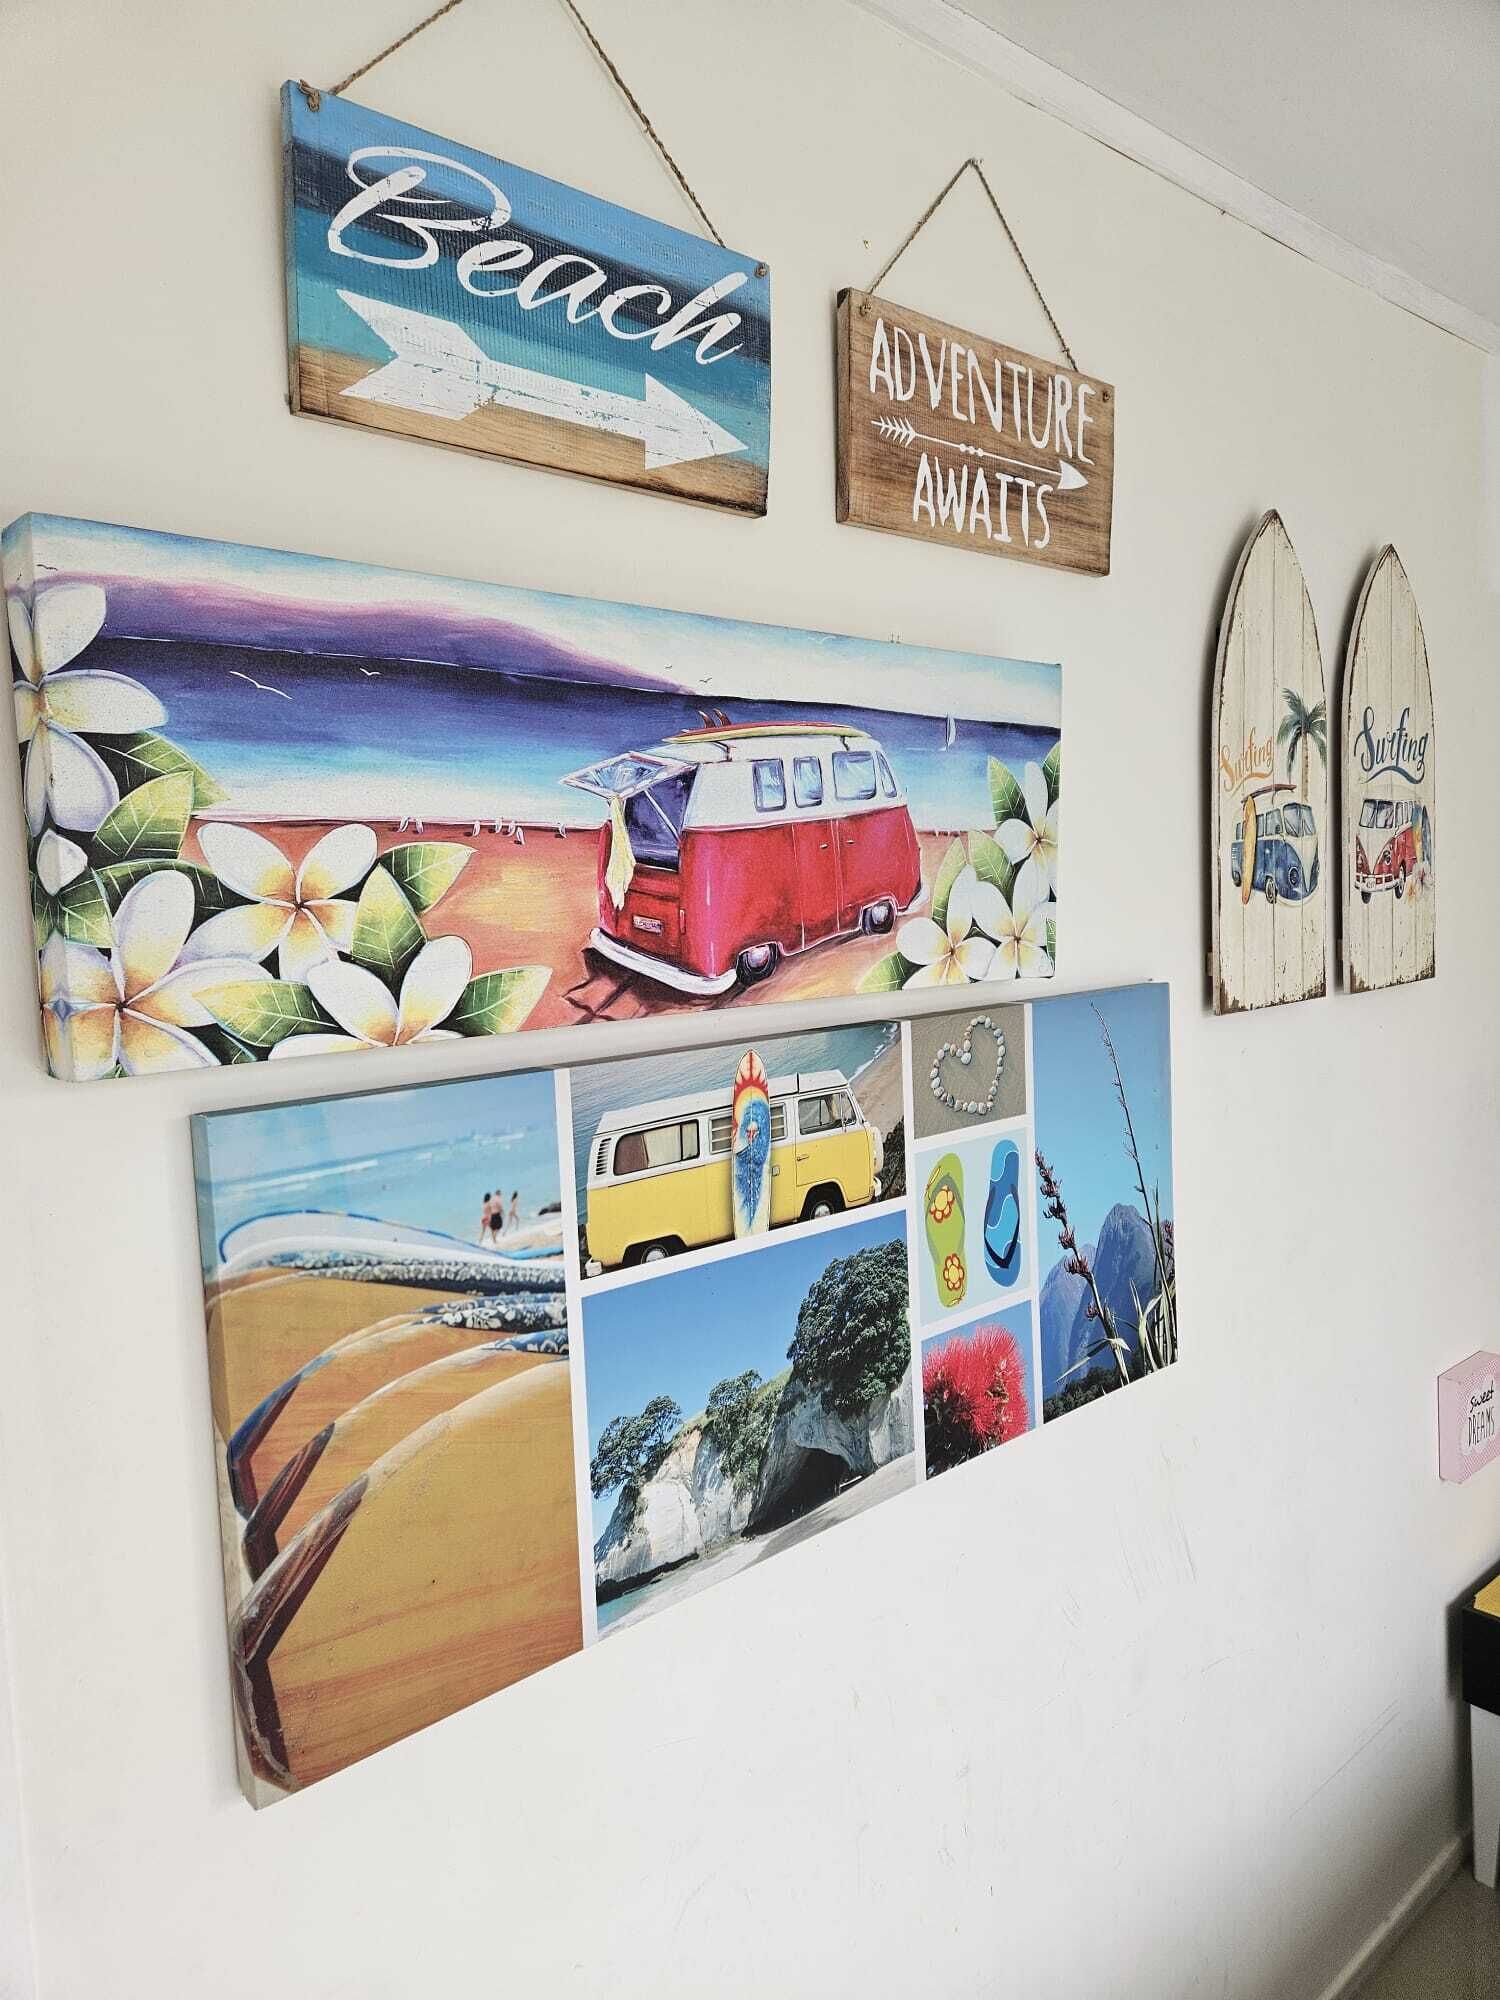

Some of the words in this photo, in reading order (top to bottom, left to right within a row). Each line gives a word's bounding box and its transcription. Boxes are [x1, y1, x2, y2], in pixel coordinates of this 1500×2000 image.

[328, 146, 749, 364] Beach
[869, 318, 1097, 465] ADVENTURE
[912, 452, 1053, 549] AWAITS
[1220, 727, 1273, 795] Surfing
[1353, 706, 1428, 784] Surfing
